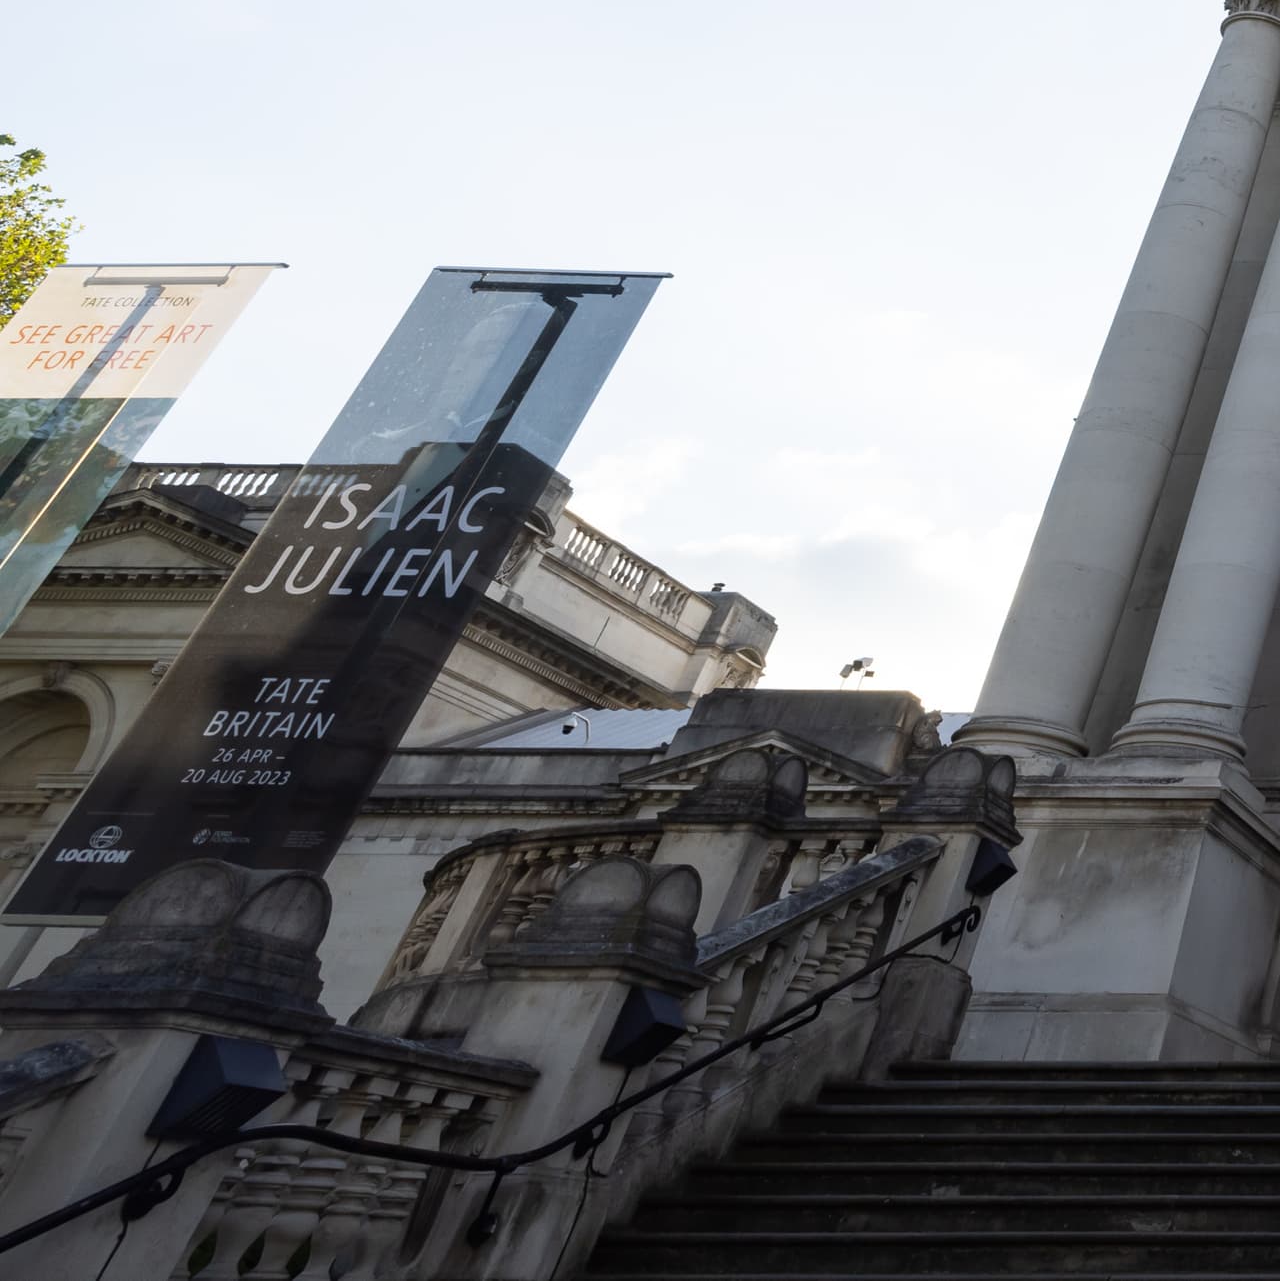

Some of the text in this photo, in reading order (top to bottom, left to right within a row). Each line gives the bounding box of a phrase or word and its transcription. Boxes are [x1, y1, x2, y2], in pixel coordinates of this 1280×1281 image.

[80, 296, 194, 308] TATE COLLECTION
[9, 324, 213, 345] SEE GREAT ART
[27, 350, 155, 370] FOR FREE
[303, 482, 506, 534] ISAAC
[244, 545, 479, 599] JULIEN
[254, 677, 331, 704] TATE
[203, 710, 336, 739] BRITAIN
[211, 747, 236, 763] 26
[237, 748, 273, 764] APR
[181, 768, 292, 786] 20 AUG 2023
[55, 848, 134, 864] LOCKTON
